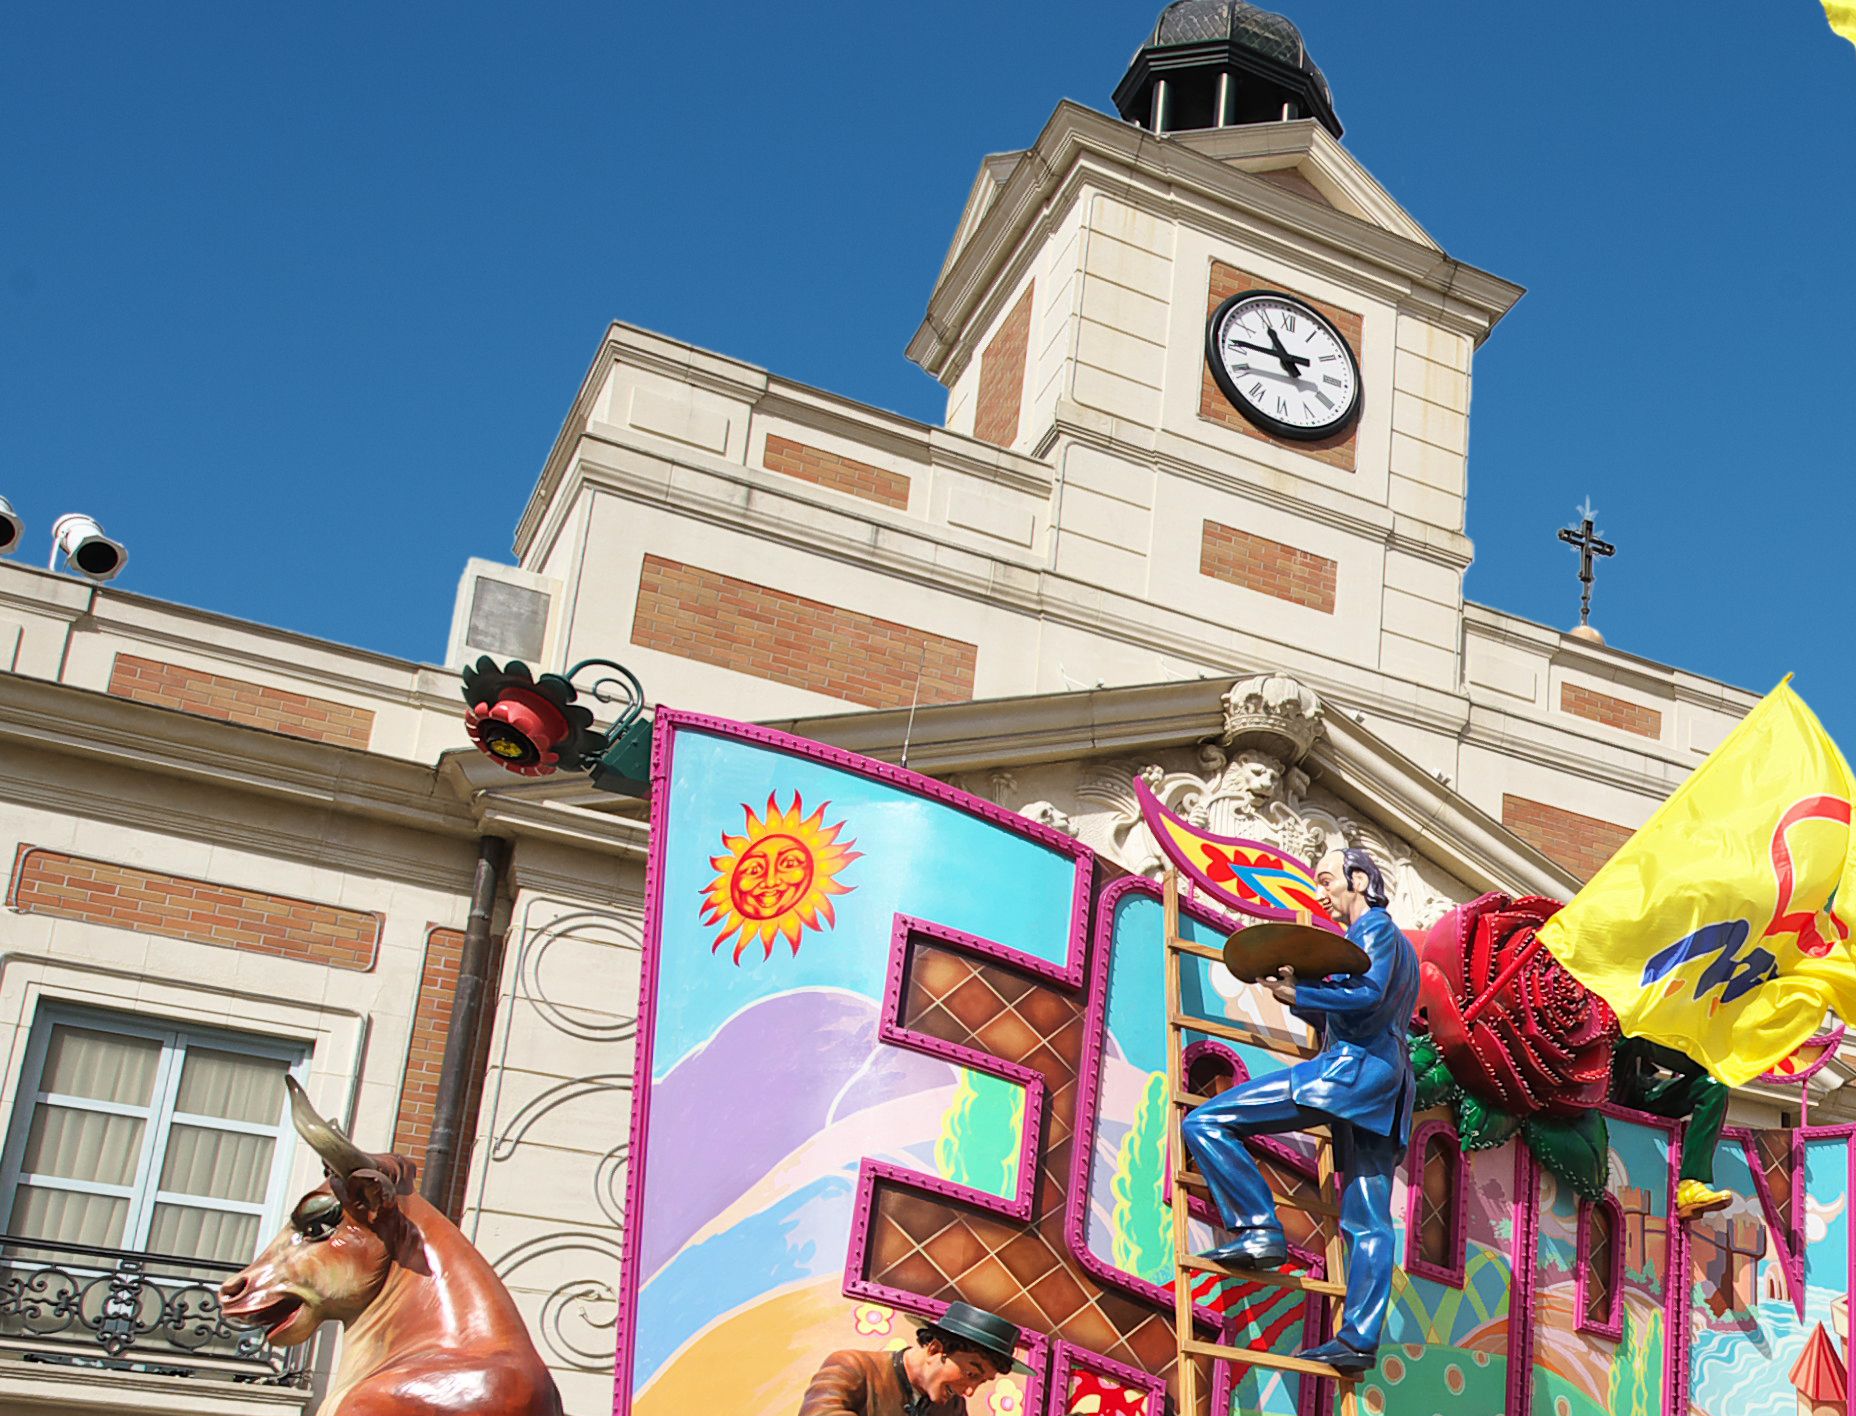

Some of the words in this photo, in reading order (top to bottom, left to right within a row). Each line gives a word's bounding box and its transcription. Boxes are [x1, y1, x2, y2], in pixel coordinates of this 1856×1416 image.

[1235, 318, 1256, 339] X
[1281, 312, 1296, 333] XII
[1305, 330, 1317, 343] I
[1318, 354, 1337, 362] II
[1249, 382, 1267, 403] VII
[1277, 396, 1288, 417] VI
[1303, 401, 1315, 420] V
